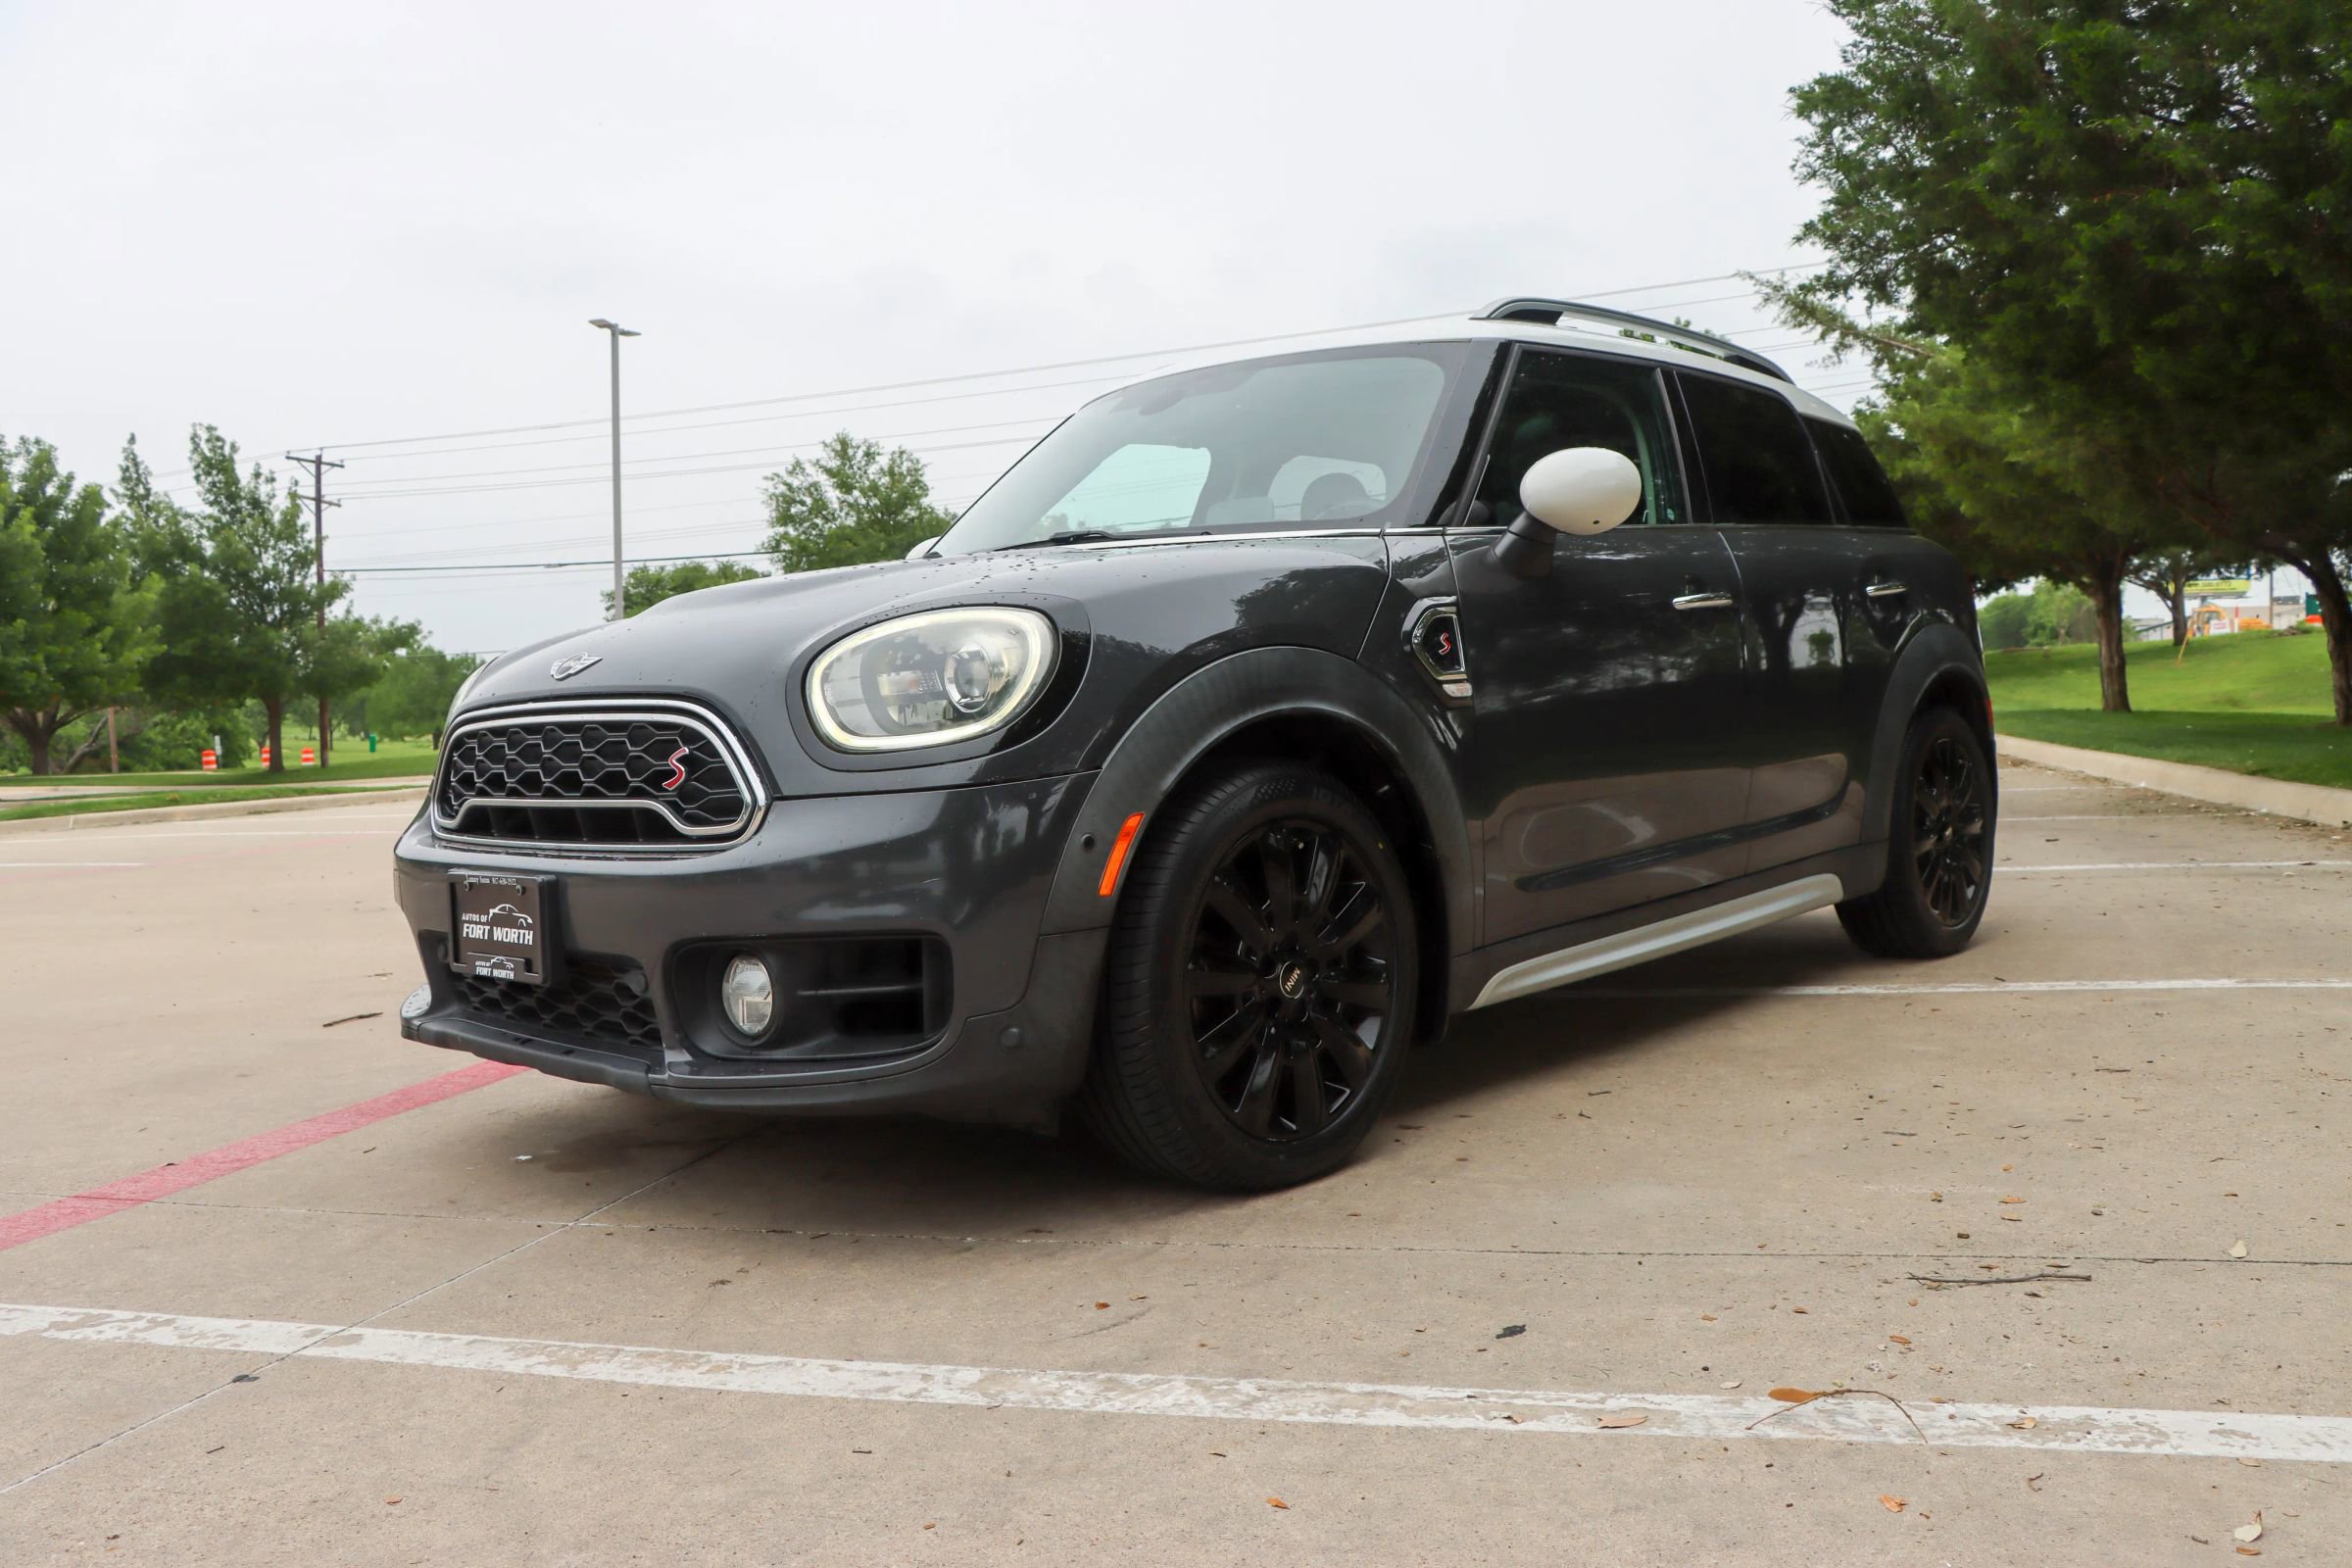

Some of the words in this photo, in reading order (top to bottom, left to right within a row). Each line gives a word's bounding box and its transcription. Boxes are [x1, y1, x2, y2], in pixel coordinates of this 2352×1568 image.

[1439, 632, 1450, 655] S
[662, 747, 689, 791] S
[462, 912, 479, 922] AUTOS
[480, 914, 488, 923] OF
[463, 923, 491, 940] FORT
[493, 926, 533, 946] WORTH
[476, 966, 492, 976] FORT
[493, 968, 514, 980] WORTH
[1285, 967, 1300, 992] MINI
